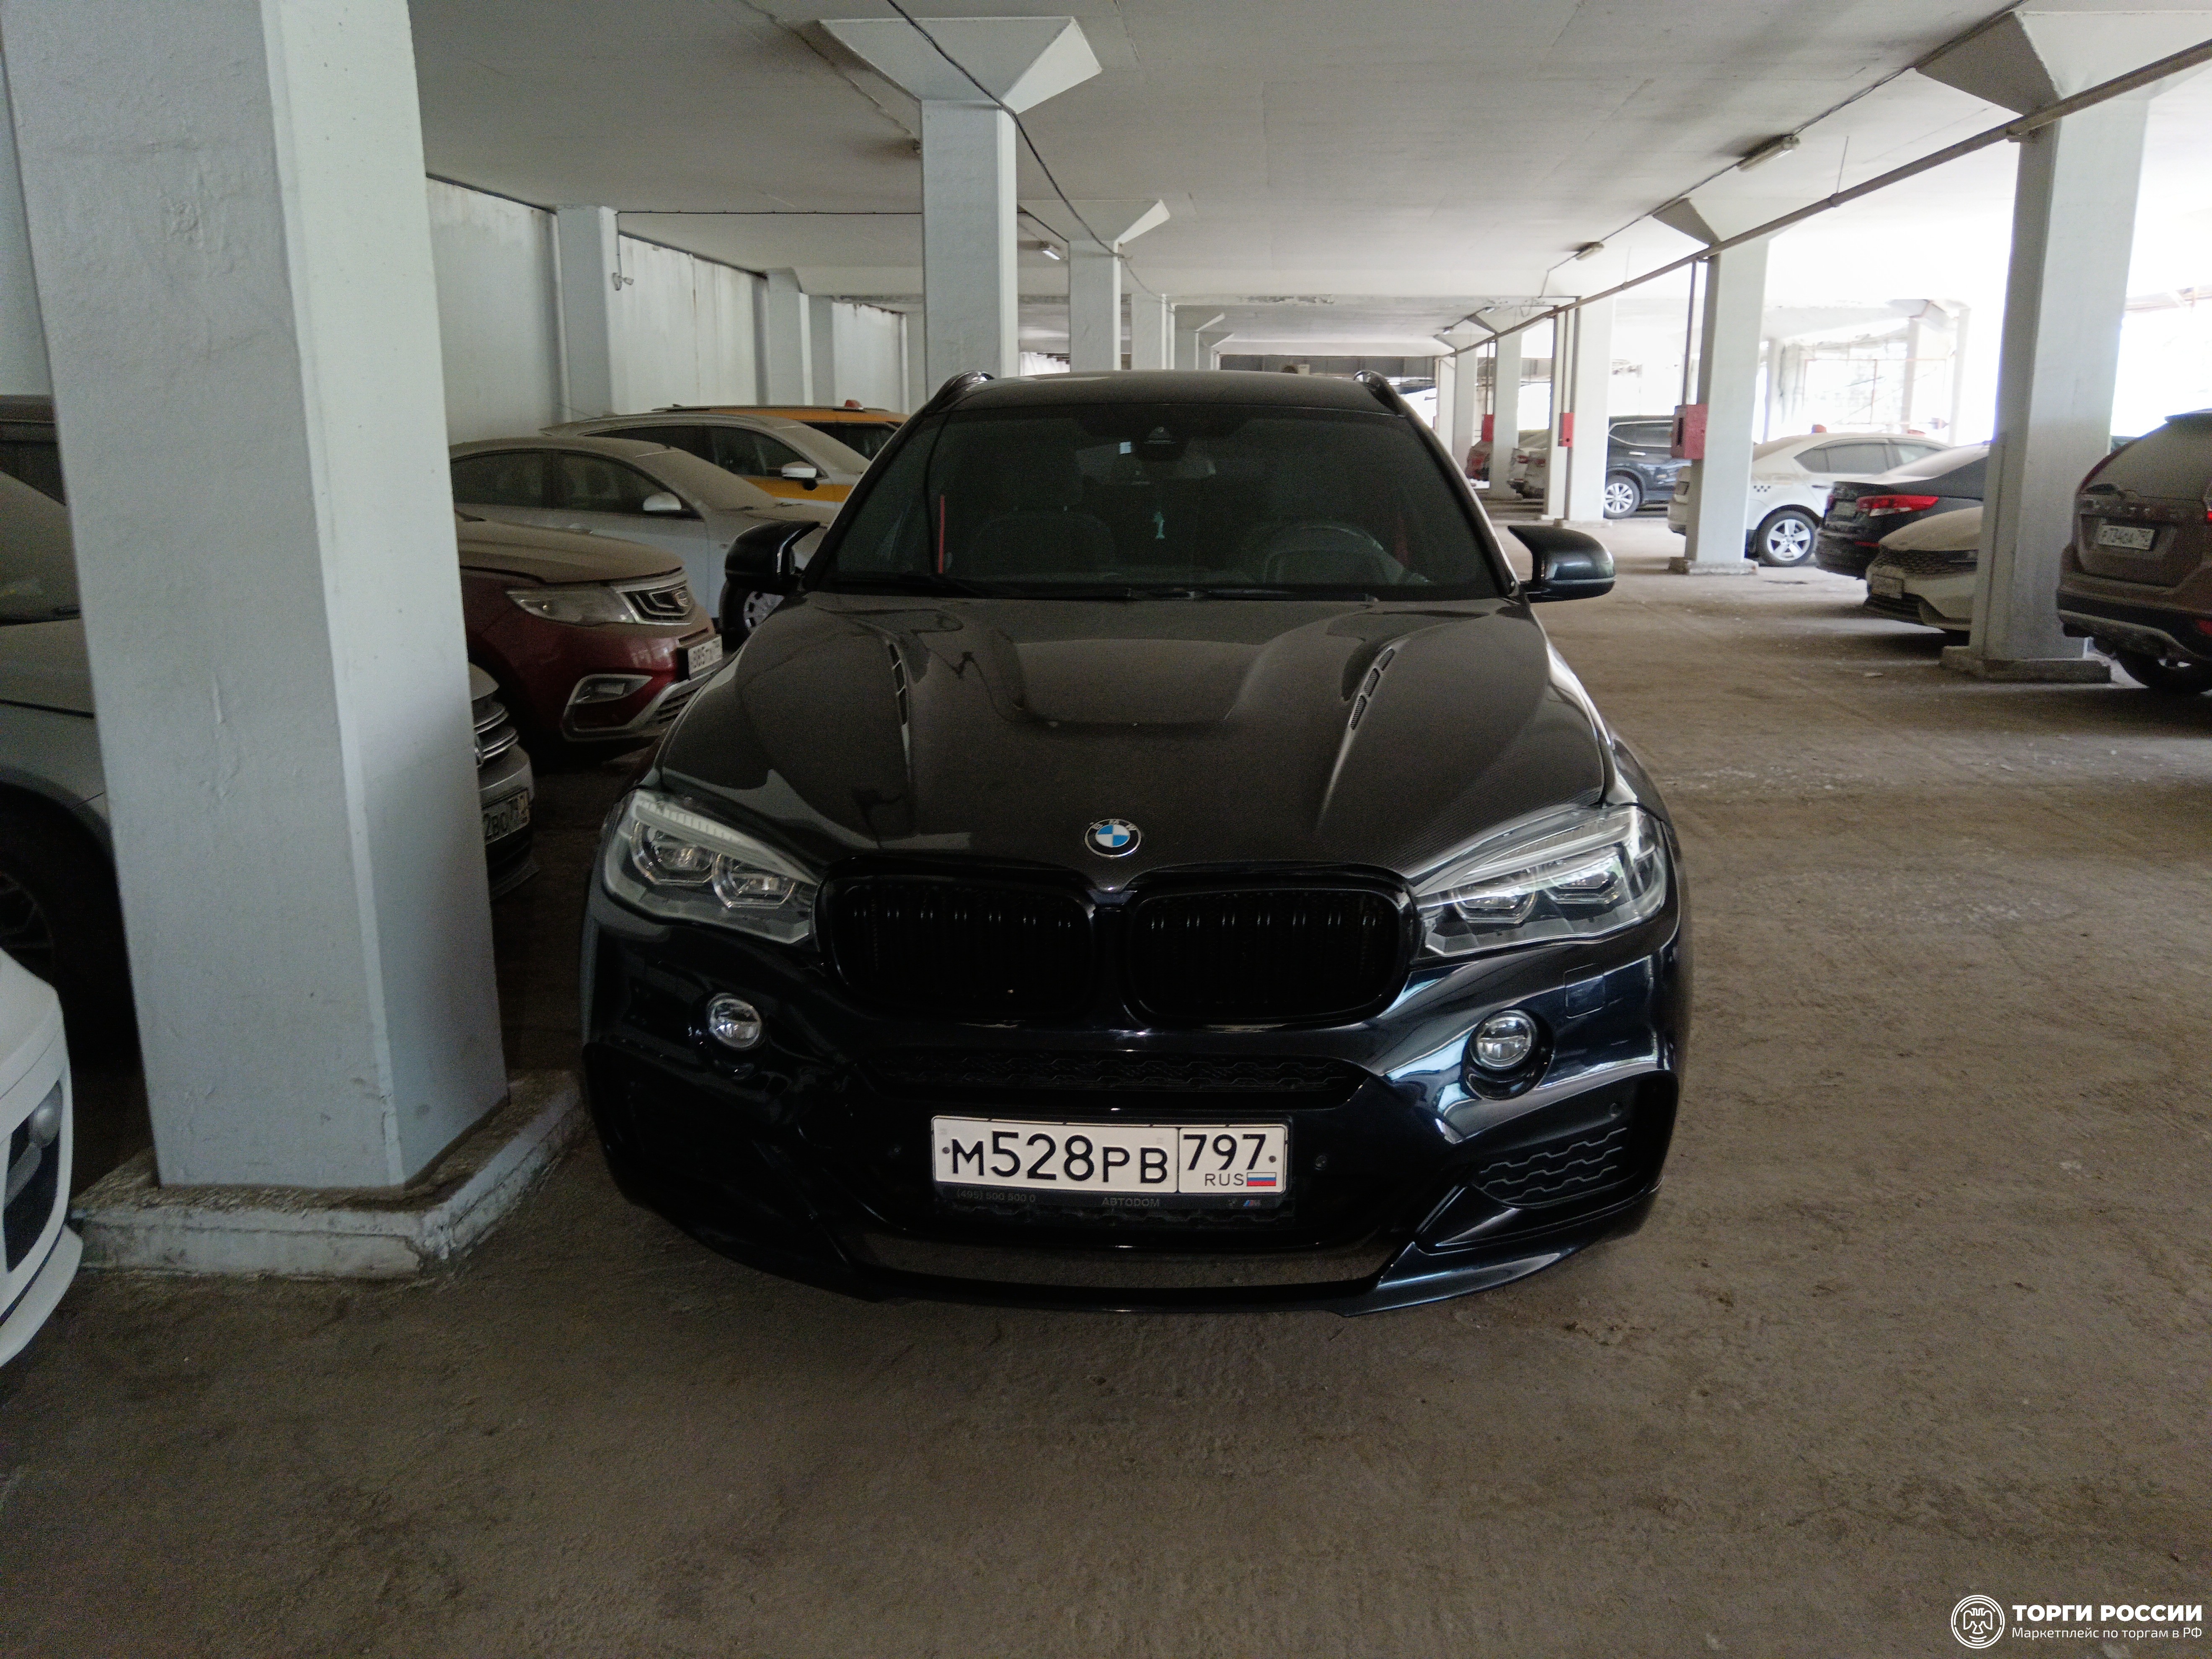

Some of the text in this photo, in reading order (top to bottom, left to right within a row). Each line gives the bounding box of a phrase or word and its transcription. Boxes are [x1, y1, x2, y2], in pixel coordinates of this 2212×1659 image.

[1092, 819, 1137, 831] BMW
[952, 1130, 1266, 1184] М528РВ 797
[1205, 1173, 1244, 1186] RUS
